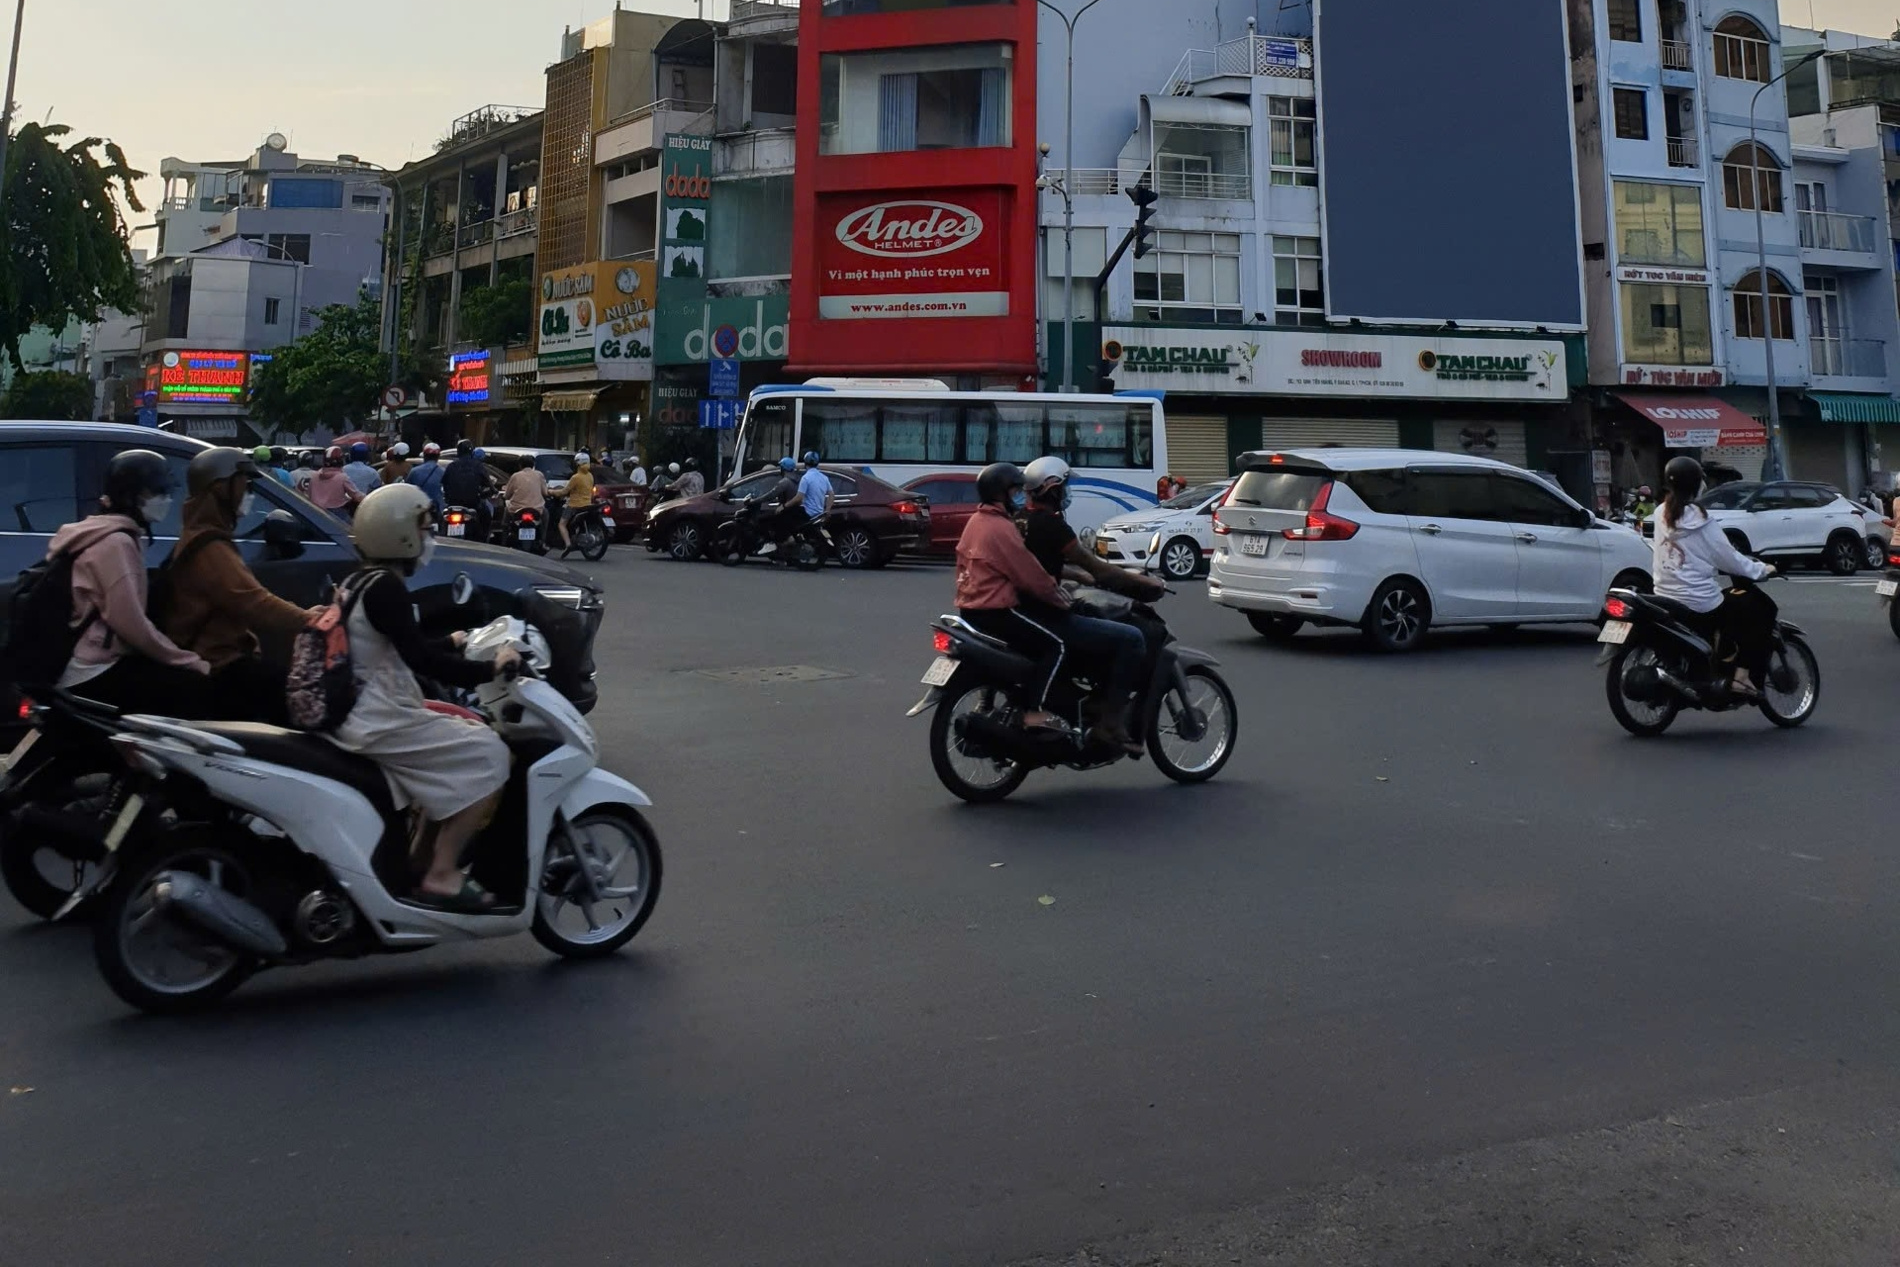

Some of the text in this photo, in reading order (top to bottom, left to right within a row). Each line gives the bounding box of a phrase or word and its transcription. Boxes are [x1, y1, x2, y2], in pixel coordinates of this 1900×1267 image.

[668, 136, 690, 151] HIỆU
[665, 160, 711, 199] dada
[841, 207, 978, 241] Andes
[845, 270, 868, 281] một
[871, 269, 901, 280] hạnh
[904, 267, 934, 280] phúc
[937, 267, 964, 278] trọn
[851, 301, 967, 313] www.andes.com.vn
[600, 339, 622, 359] Cô
[624, 339, 652, 359] Ba
[1301, 349, 1382, 369] SHOWROOM
[1645, 407, 1721, 420] LOSHIP
